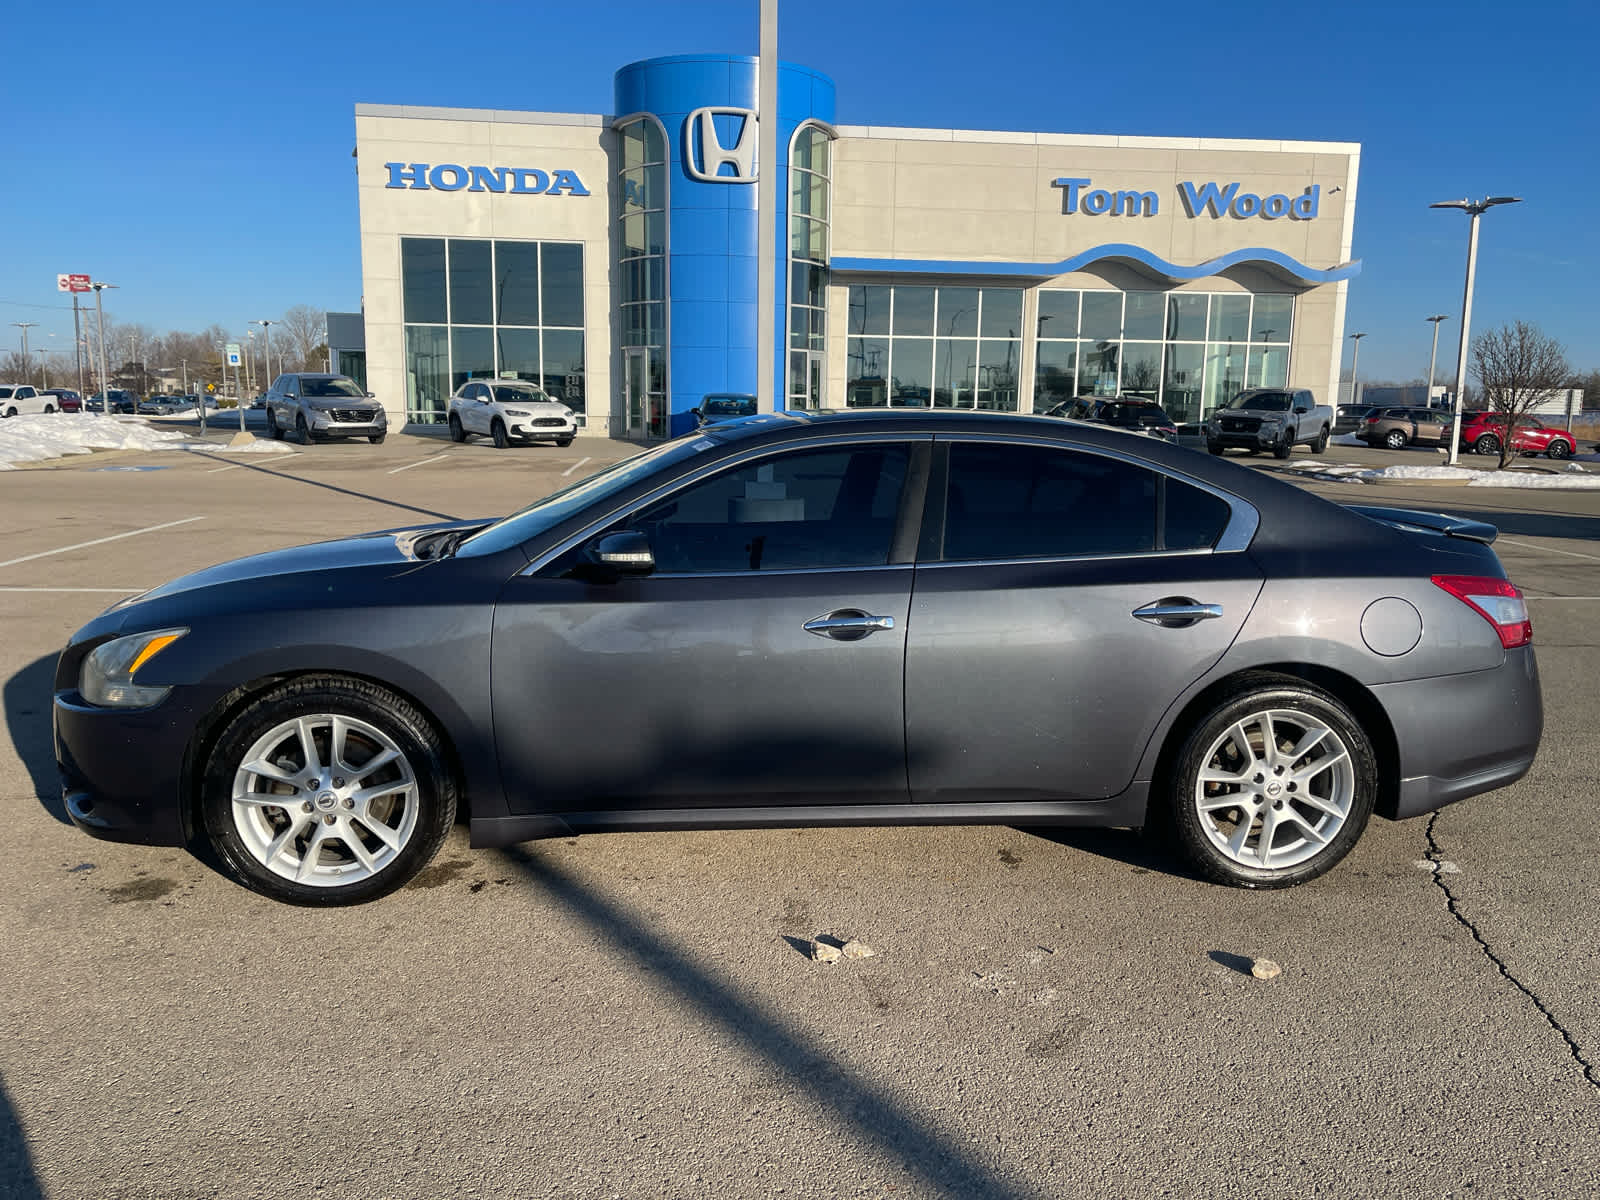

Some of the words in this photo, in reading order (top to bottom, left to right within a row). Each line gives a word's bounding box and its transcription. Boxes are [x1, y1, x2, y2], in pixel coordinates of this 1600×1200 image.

[384, 162, 591, 196] HONDA
[1054, 177, 1160, 215] Tom
[1179, 181, 1321, 219] Wood
